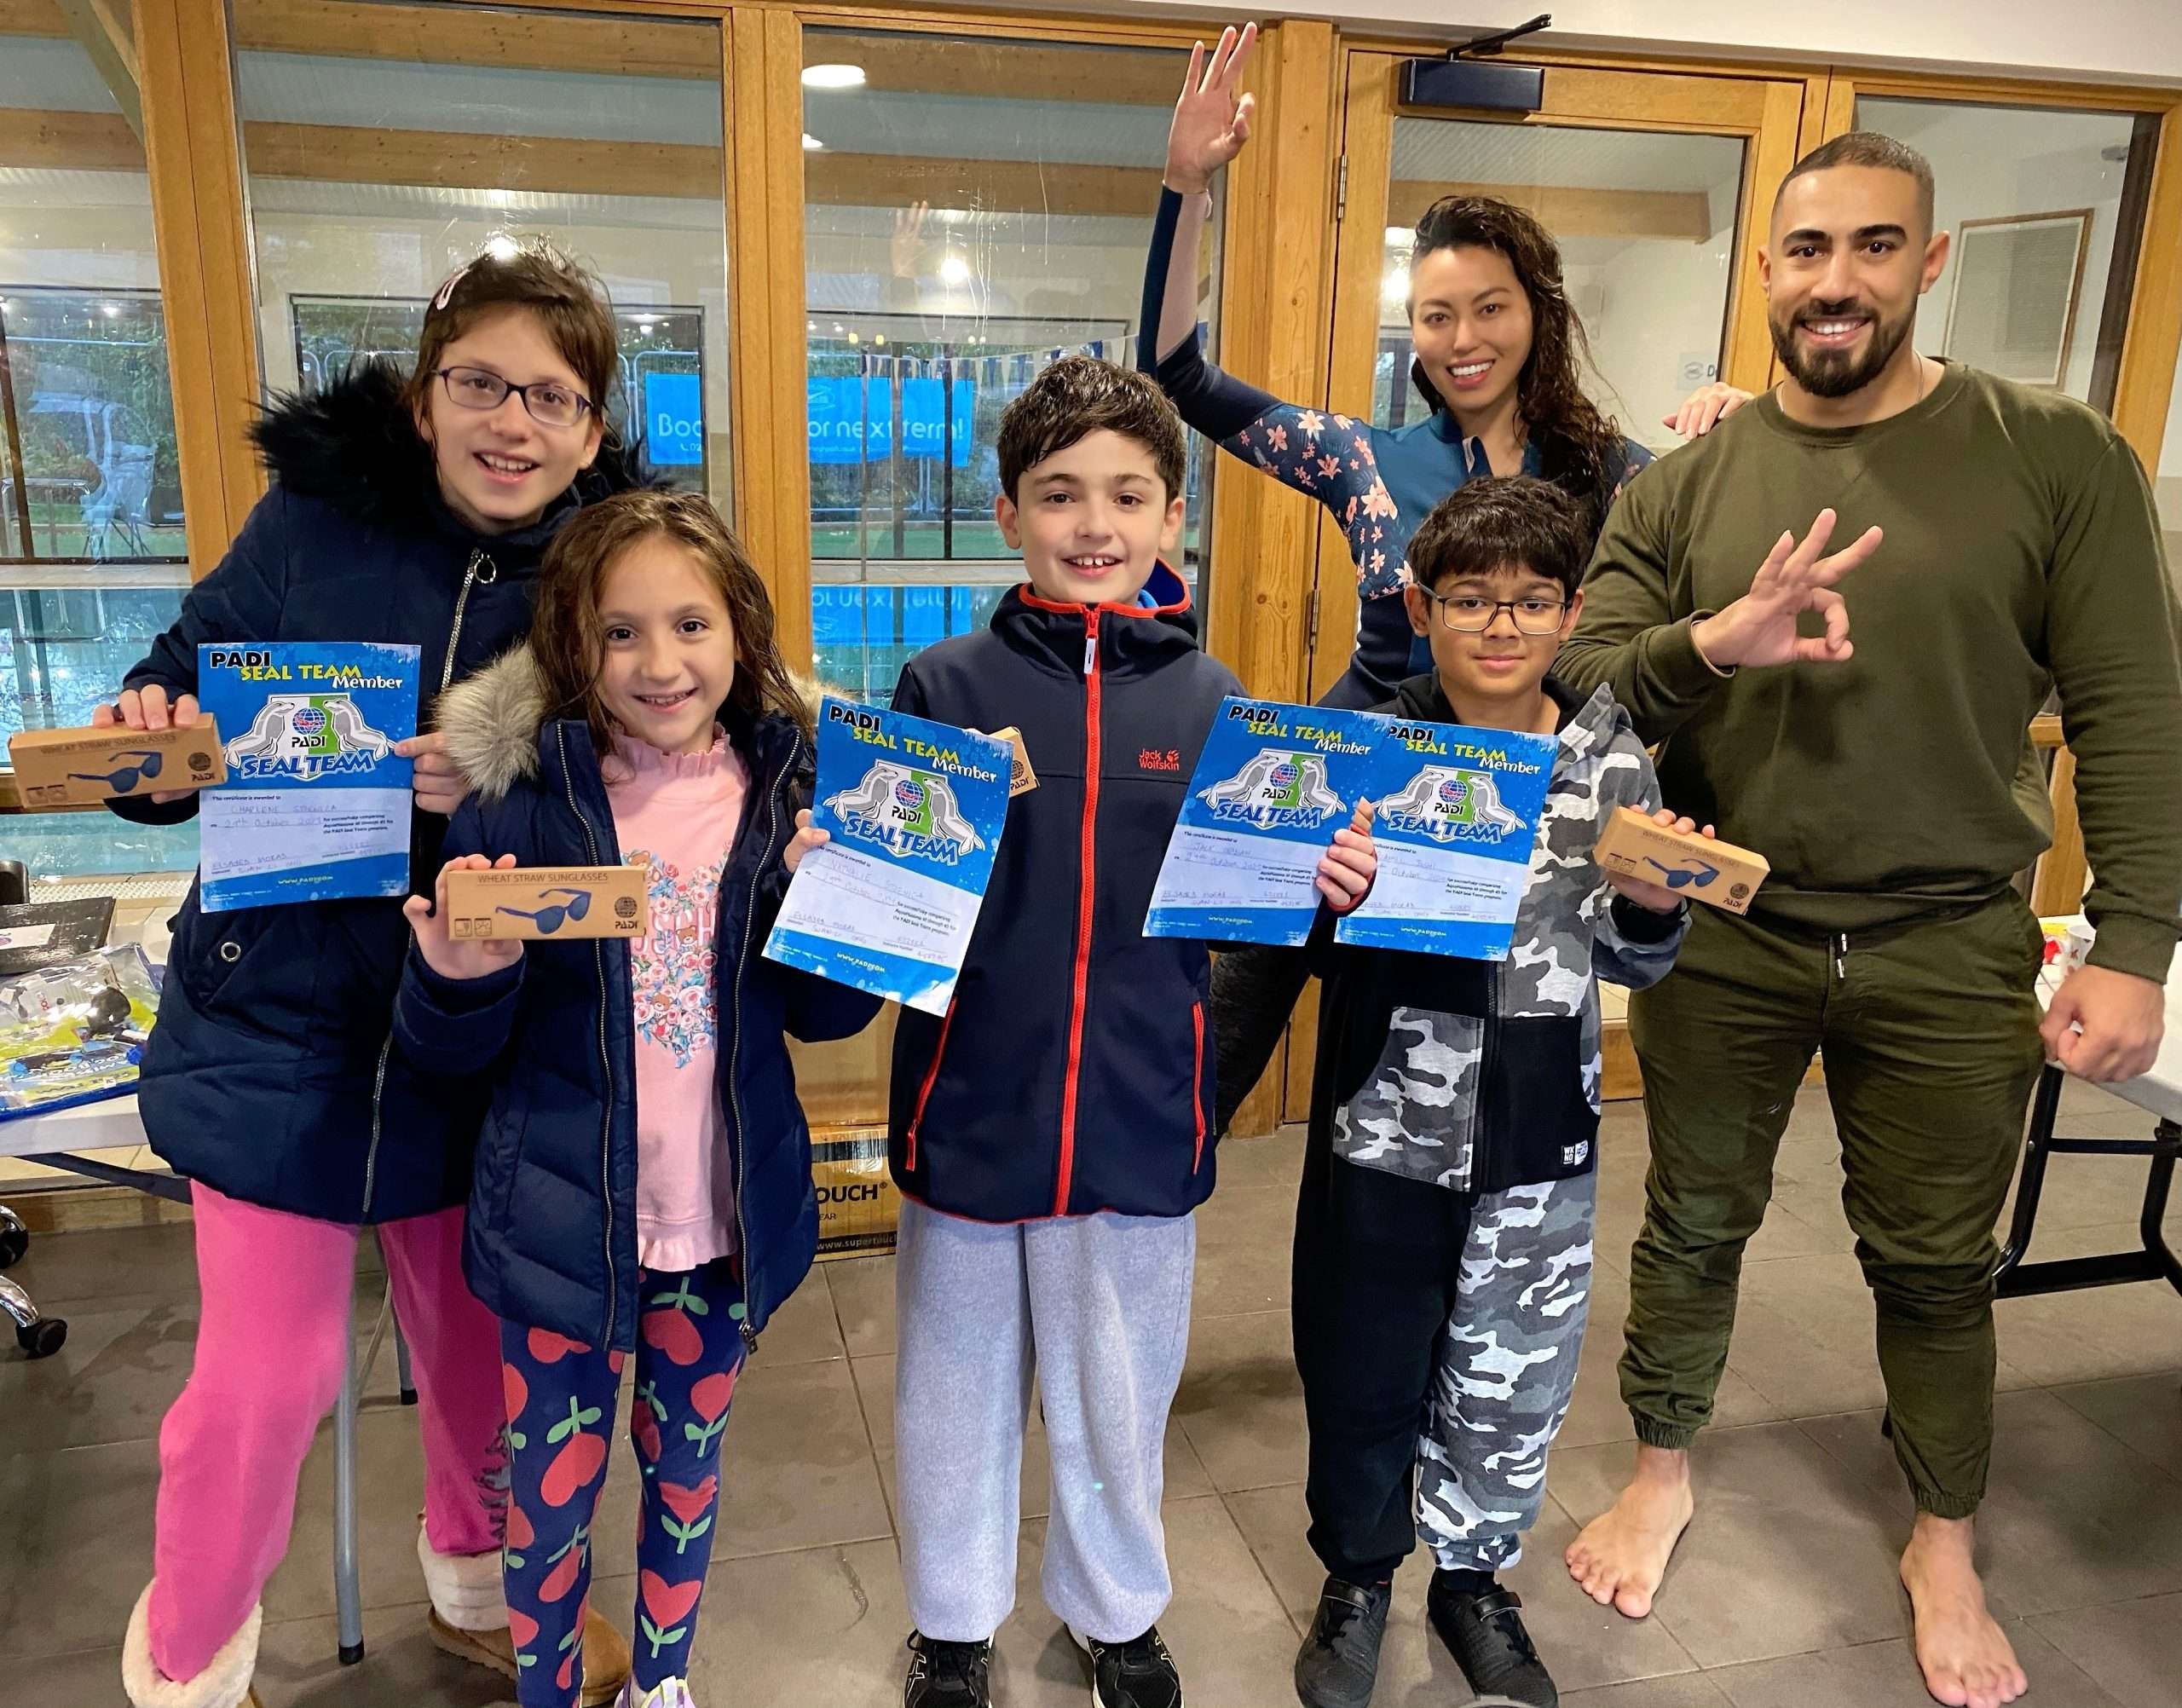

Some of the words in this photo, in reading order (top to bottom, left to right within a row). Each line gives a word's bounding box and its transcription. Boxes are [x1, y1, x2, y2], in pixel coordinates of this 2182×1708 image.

[808, 420, 829, 437] or
[211, 651, 271, 668] PADI
[240, 665, 292, 681] SEAL
[298, 665, 361, 679] TEAM
[332, 676, 403, 689] Member
[829, 706, 881, 732] PADI
[1228, 705, 1280, 724] PADI
[1247, 721, 1288, 737] SEAL
[1296, 725, 1342, 743] TEAM
[1388, 725, 1434, 742] PADI
[292, 736, 326, 747] PADI
[852, 726, 898, 750] SEAL
[903, 738, 960, 765] TEAM
[1314, 739, 1371, 755] Member
[1139, 748, 1161, 760] Jack
[1406, 740, 1447, 755] SEAL
[1454, 744, 1506, 762] TEAM
[241, 753, 302, 779] SEAL
[303, 750, 376, 777] TEAM
[932, 757, 996, 783] Member
[1139, 759, 1180, 770] Wolfskin
[1479, 757, 1540, 775] Member
[1010, 777, 1029, 790] PADI
[1261, 788, 1291, 799] PADI
[892, 805, 921, 823] PADI
[1214, 802, 1266, 822] SEAL
[1266, 805, 1321, 829] TEAM
[1434, 803, 1464, 815] PADI
[1388, 814, 1440, 836] SEAL
[1440, 820, 1502, 844] TEAM
[845, 816, 898, 846] SEAL
[898, 829, 959, 866] TEAM
[477, 874, 511, 884] WHEAT
[514, 874, 546, 883] STRAW
[548, 873, 608, 882] SUNGLASSES
[615, 920, 638, 930] PADI
[816, 1184, 878, 1204] OUCH
[818, 1213, 836, 1221] EAR
[817, 1234, 897, 1250] www.supertouc
